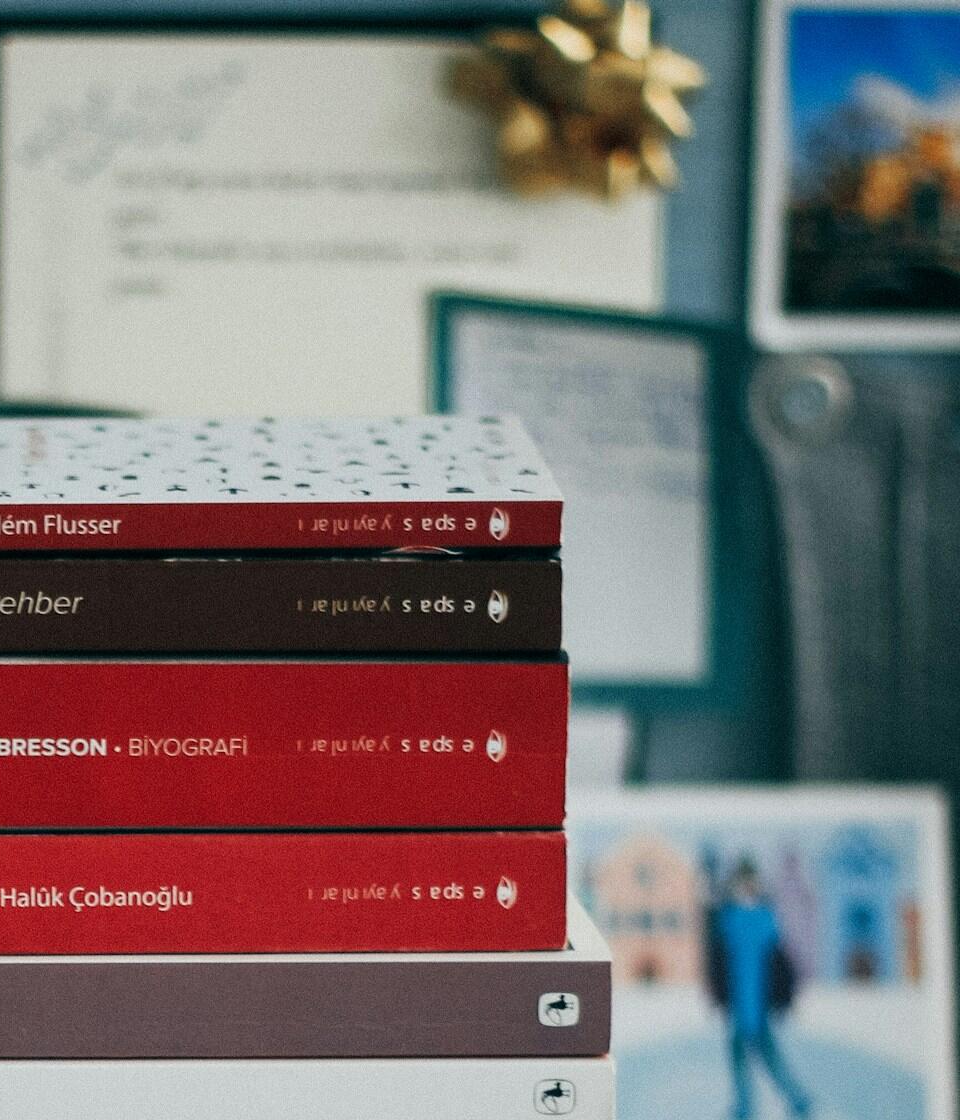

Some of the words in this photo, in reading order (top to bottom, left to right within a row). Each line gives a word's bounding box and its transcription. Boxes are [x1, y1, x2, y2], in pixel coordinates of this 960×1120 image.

[43, 513, 122, 535] Flusser
[128, 737, 248, 757] BİYOGRAFİ
[0, 886, 65, 908] Halûk
[67, 885, 193, 913] Çobanoğlu
